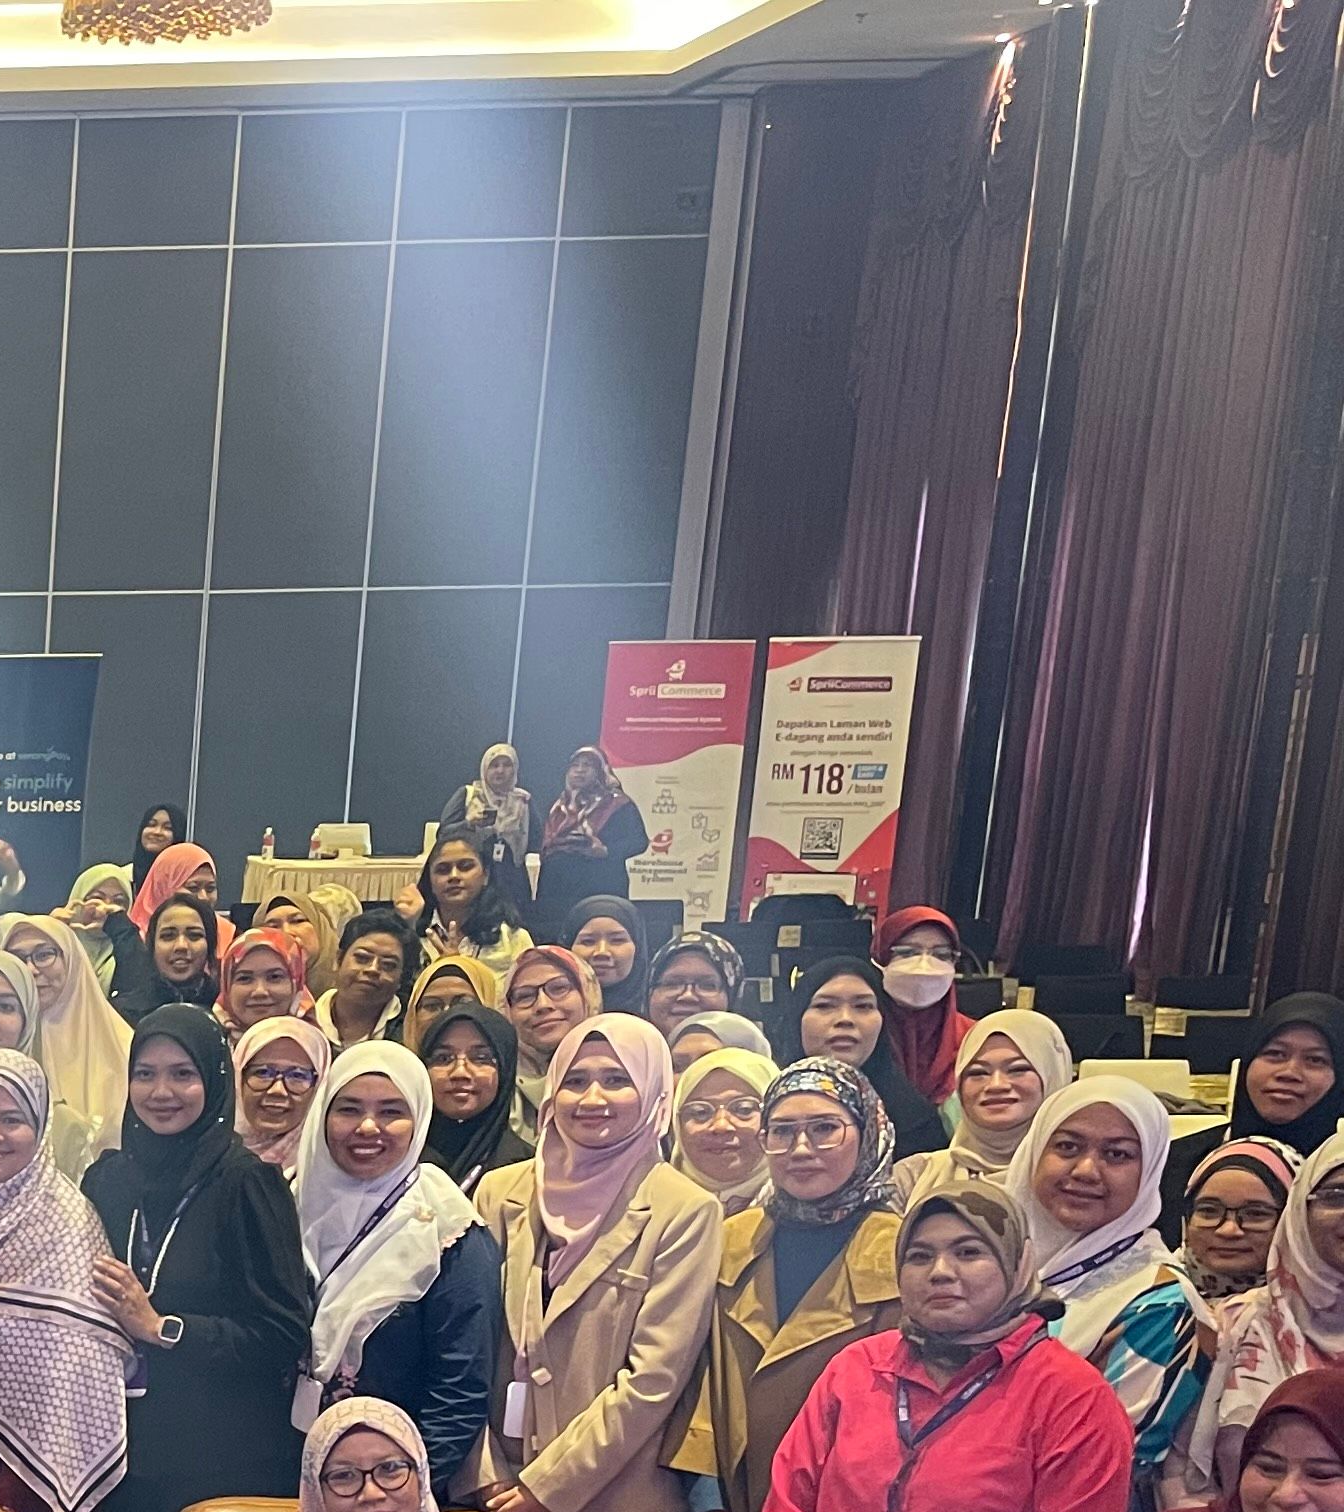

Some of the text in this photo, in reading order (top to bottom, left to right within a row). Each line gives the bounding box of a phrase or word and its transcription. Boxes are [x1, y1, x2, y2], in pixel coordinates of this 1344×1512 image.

[660, 686, 722, 696] Commerce
[776, 720, 892, 729] Dapatkan Laman Web
[827, 732, 853, 741] anda
[856, 732, 892, 741] sendiri
[772, 763, 794, 780] RM
[4, 772, 73, 794] simplify
[6, 796, 82, 812] business
